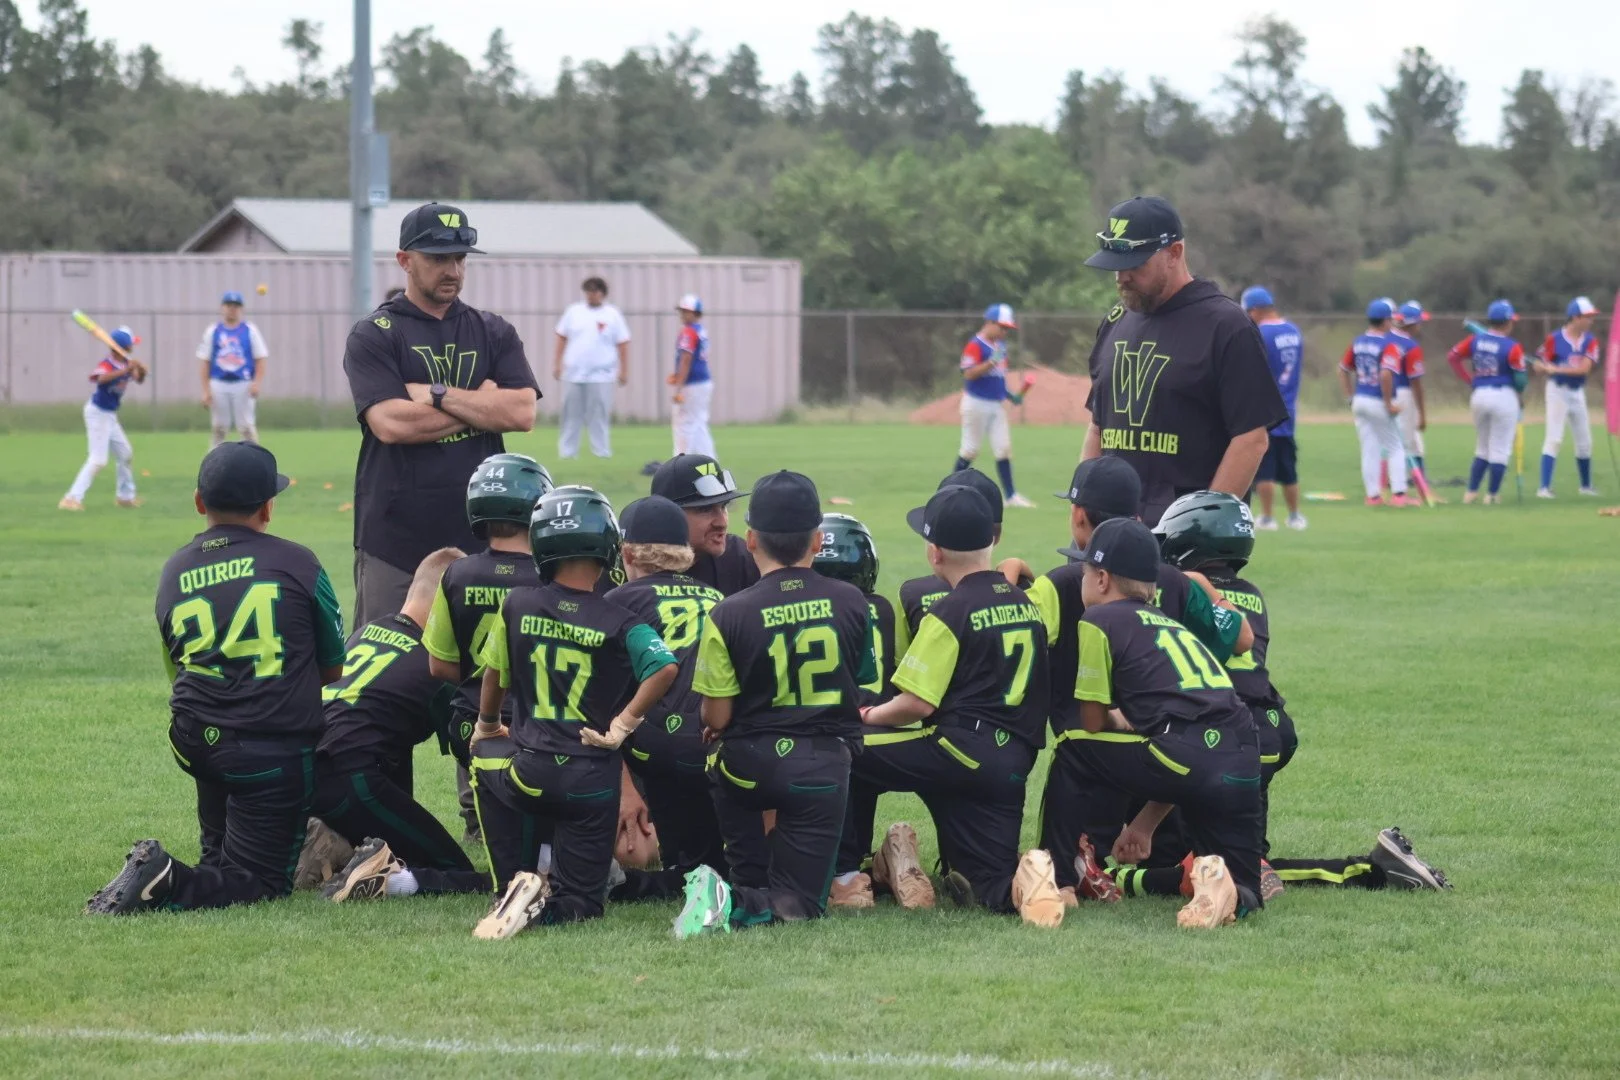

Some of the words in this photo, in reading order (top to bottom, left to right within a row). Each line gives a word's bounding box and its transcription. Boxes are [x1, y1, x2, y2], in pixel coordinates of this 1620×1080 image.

[1140, 431, 1178, 455] CLUB
[485, 467, 504, 479] 44
[556, 501, 574, 517] 17
[179, 557, 255, 594] QUIROZ
[761, 599, 834, 629] ESQUER
[171, 582, 285, 680] 24
[360, 623, 419, 654] DURNEZ
[521, 615, 606, 647] GUERRERO
[530, 643, 592, 722] 17
[767, 625, 843, 708] 12
[1002, 628, 1034, 706] 7
